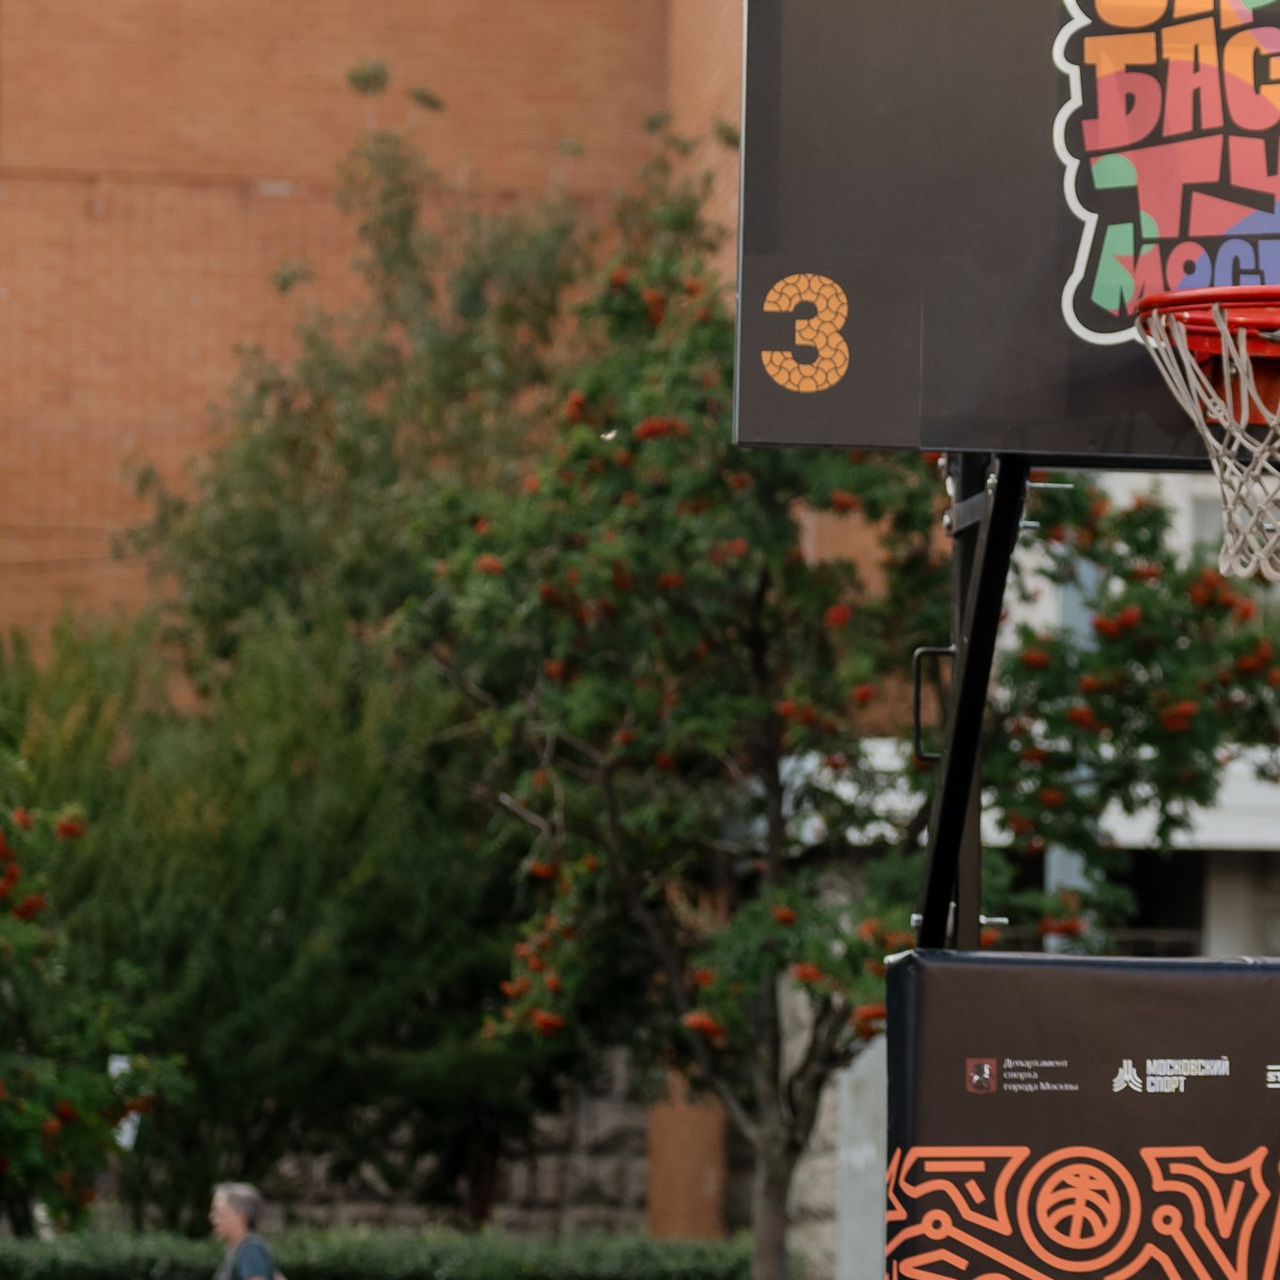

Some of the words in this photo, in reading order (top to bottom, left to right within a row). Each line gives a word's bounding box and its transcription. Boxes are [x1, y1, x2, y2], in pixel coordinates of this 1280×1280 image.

[760, 273, 850, 393] 3
[1146, 1055, 1230, 1076] МОСКОВСКИЙ
[1146, 1076, 1187, 1093] СПОРТ
